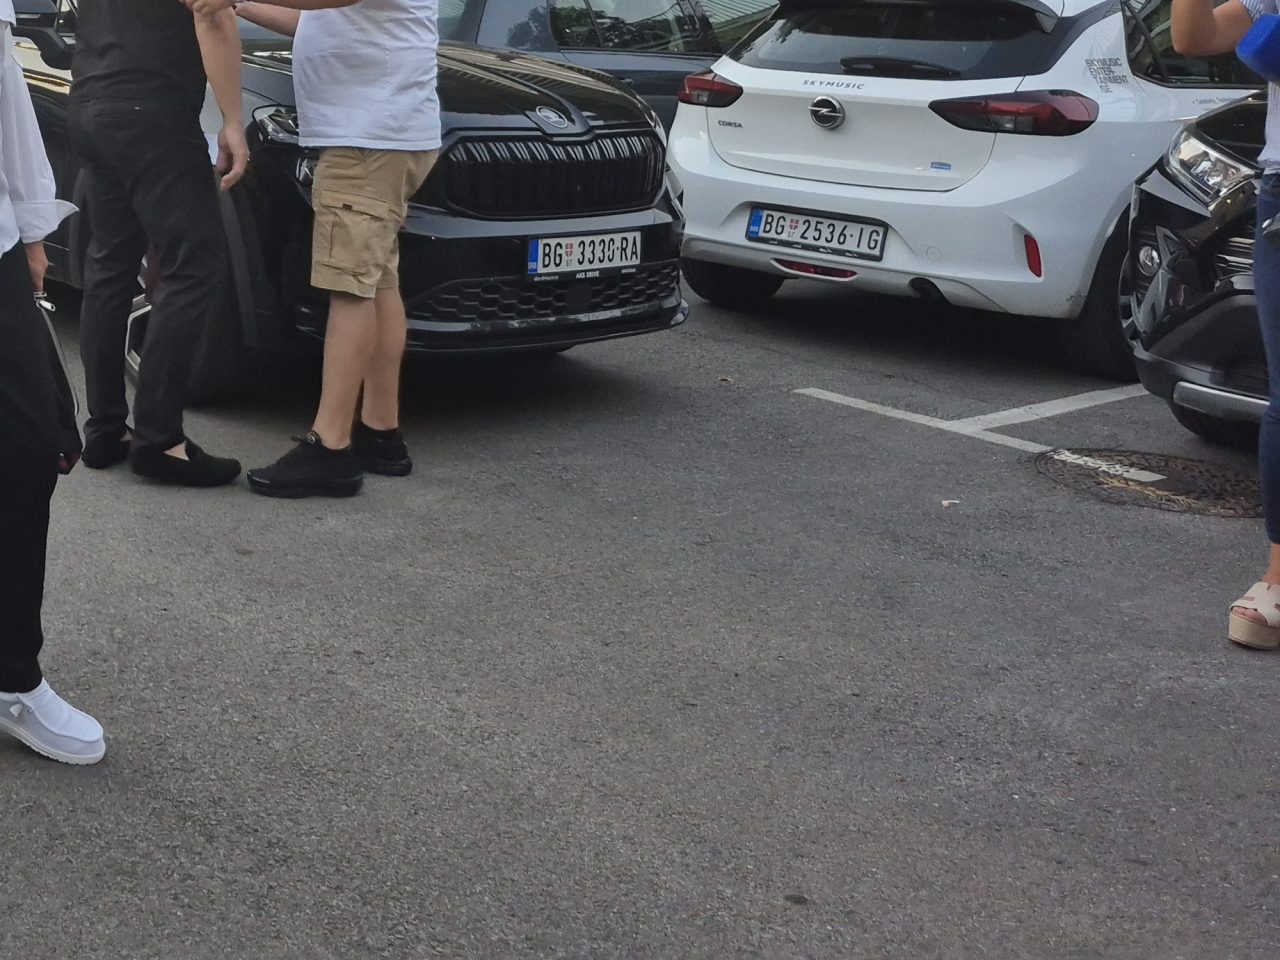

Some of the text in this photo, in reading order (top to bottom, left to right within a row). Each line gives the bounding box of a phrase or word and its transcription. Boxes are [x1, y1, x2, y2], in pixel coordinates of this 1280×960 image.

[802, 79, 864, 90] SKYMUSIC
[718, 120, 743, 128] CORSA
[763, 214, 786, 235] BG
[542, 242, 563, 268] BG
